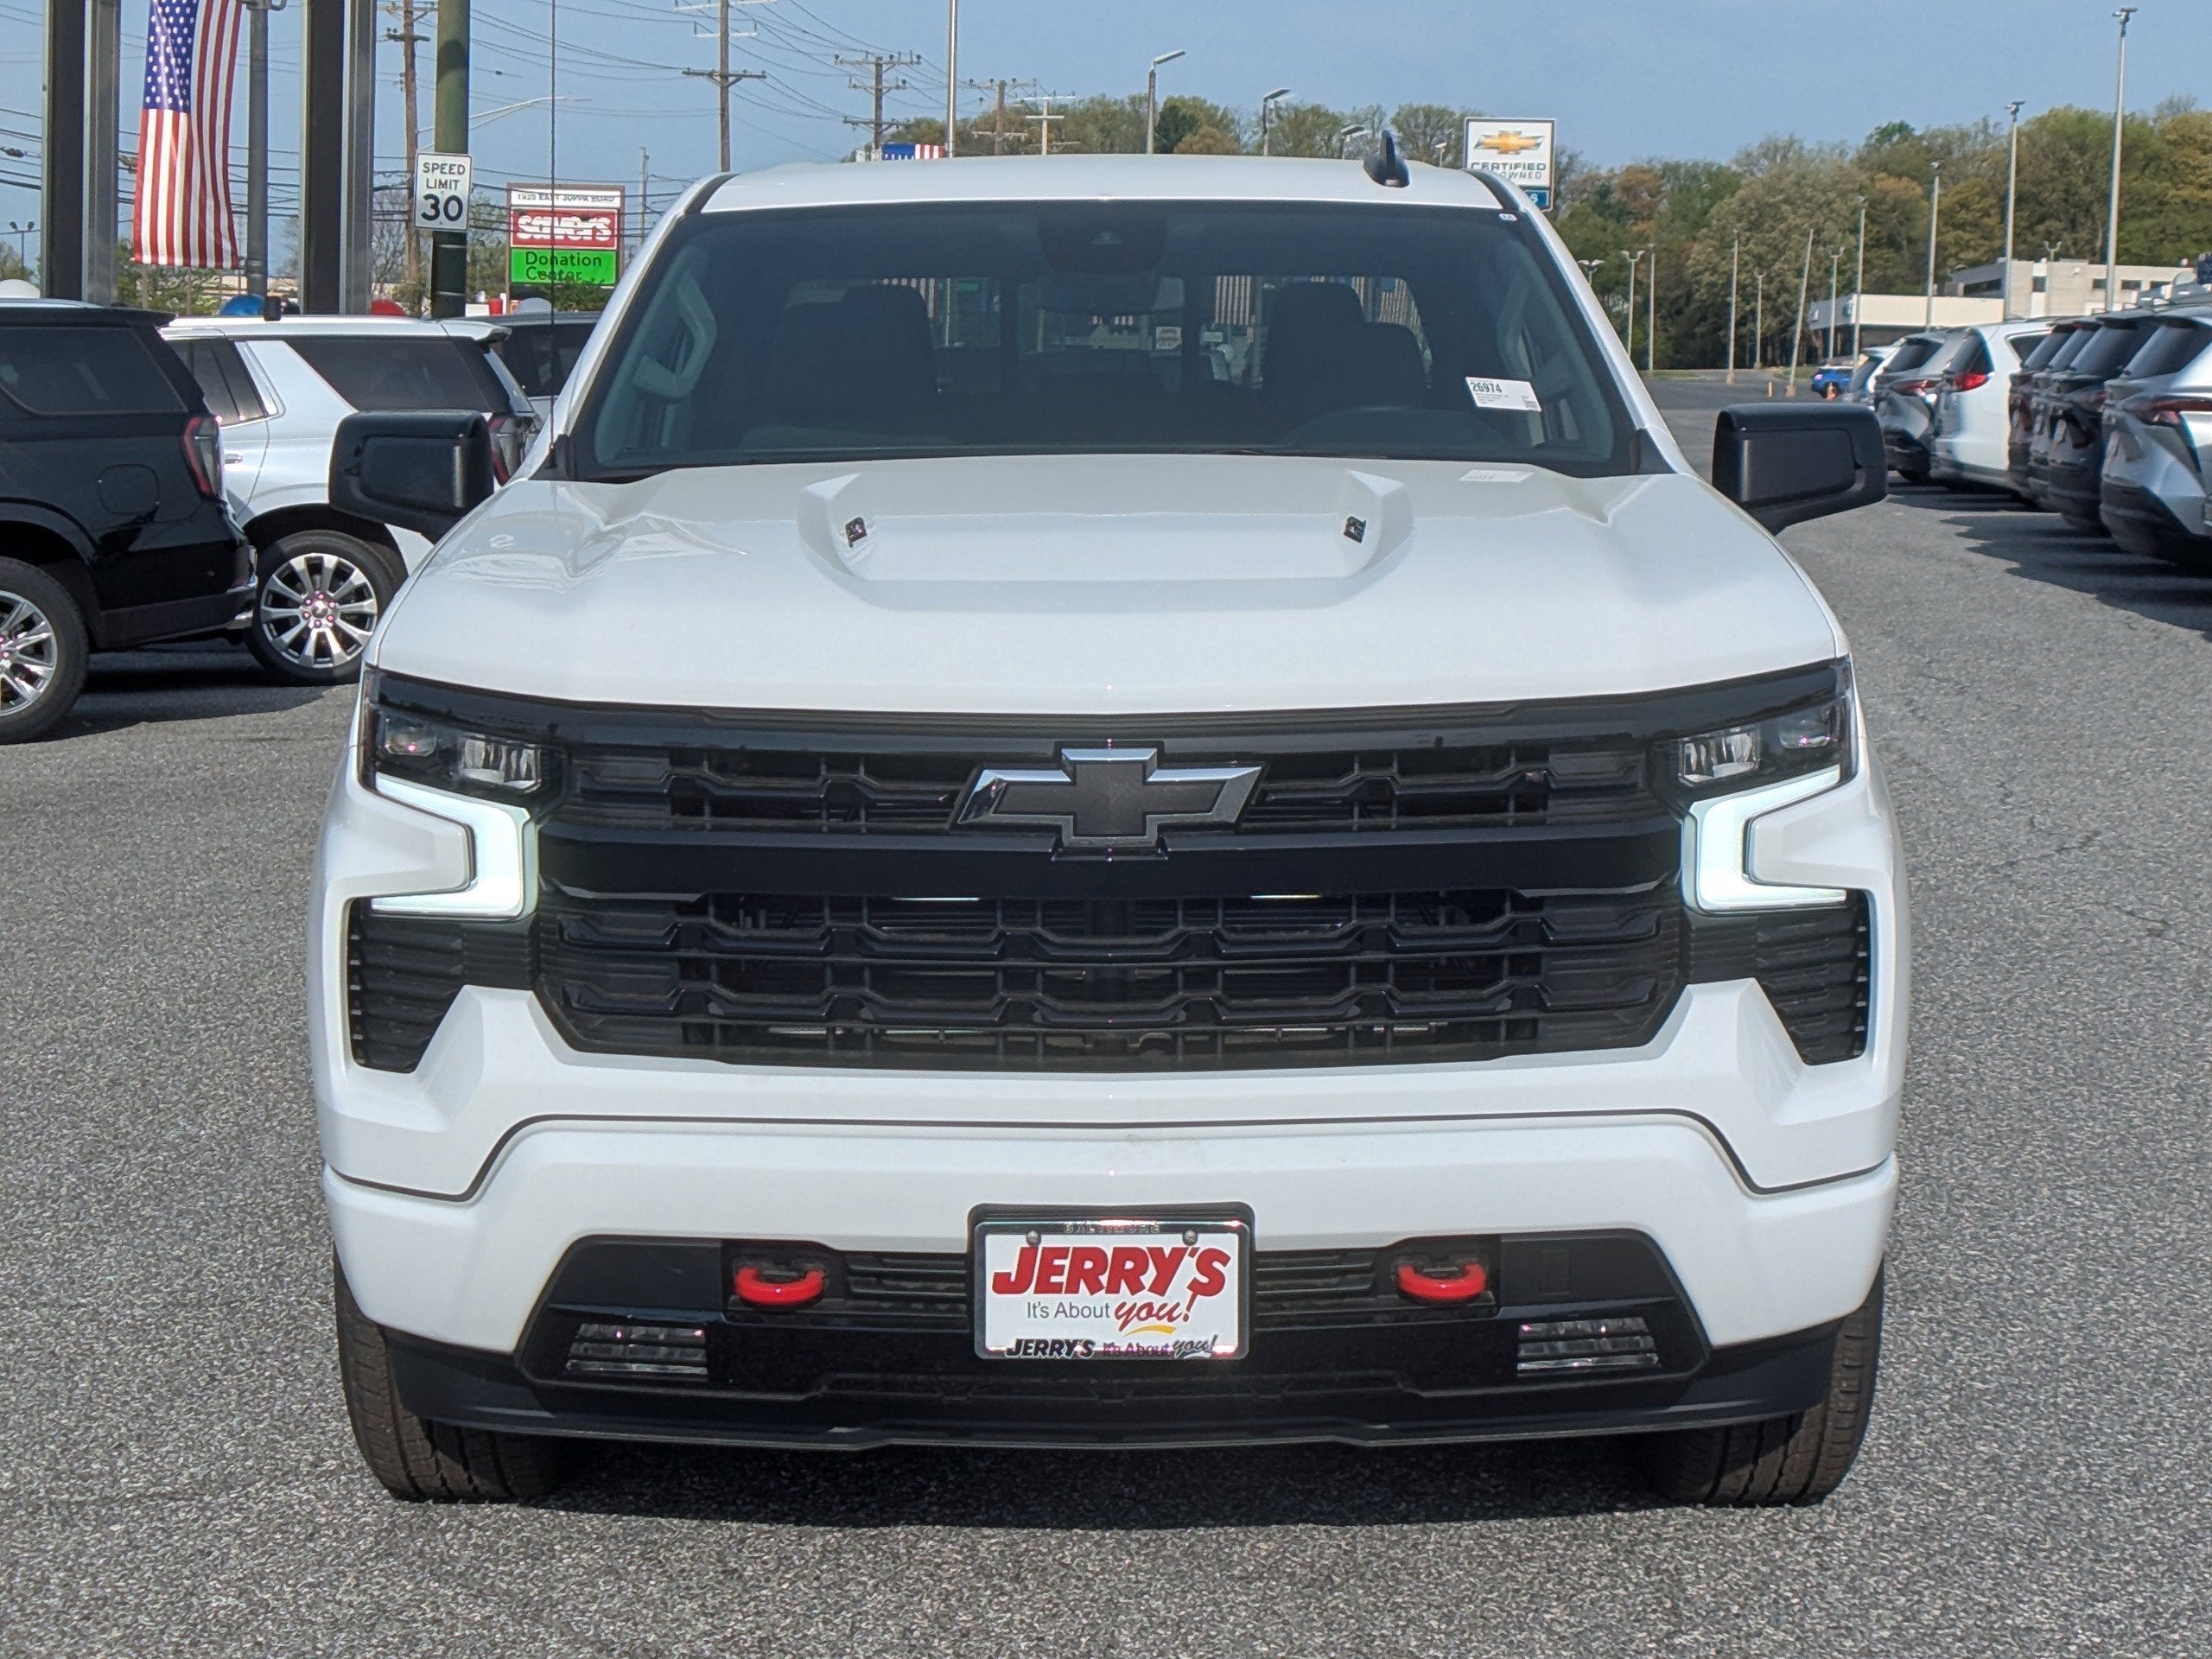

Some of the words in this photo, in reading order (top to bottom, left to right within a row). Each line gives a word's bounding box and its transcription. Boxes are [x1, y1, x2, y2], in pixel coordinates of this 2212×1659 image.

[423, 162, 466, 175] SPEED
[1471, 162, 1547, 171] CERTIFIED
[426, 178, 461, 190] LIMIT
[421, 194, 463, 221] 30
[525, 251, 602, 267] Donation
[1471, 382, 1503, 393] 26974
[992, 1246, 1232, 1297] JERRY'S
[1027, 1301, 1050, 1319] It's
[1054, 1301, 1110, 1319] About
[1114, 1293, 1198, 1332] you!
[1004, 1338, 1096, 1359] JERRY'S
[1172, 1334, 1219, 1359] you!
